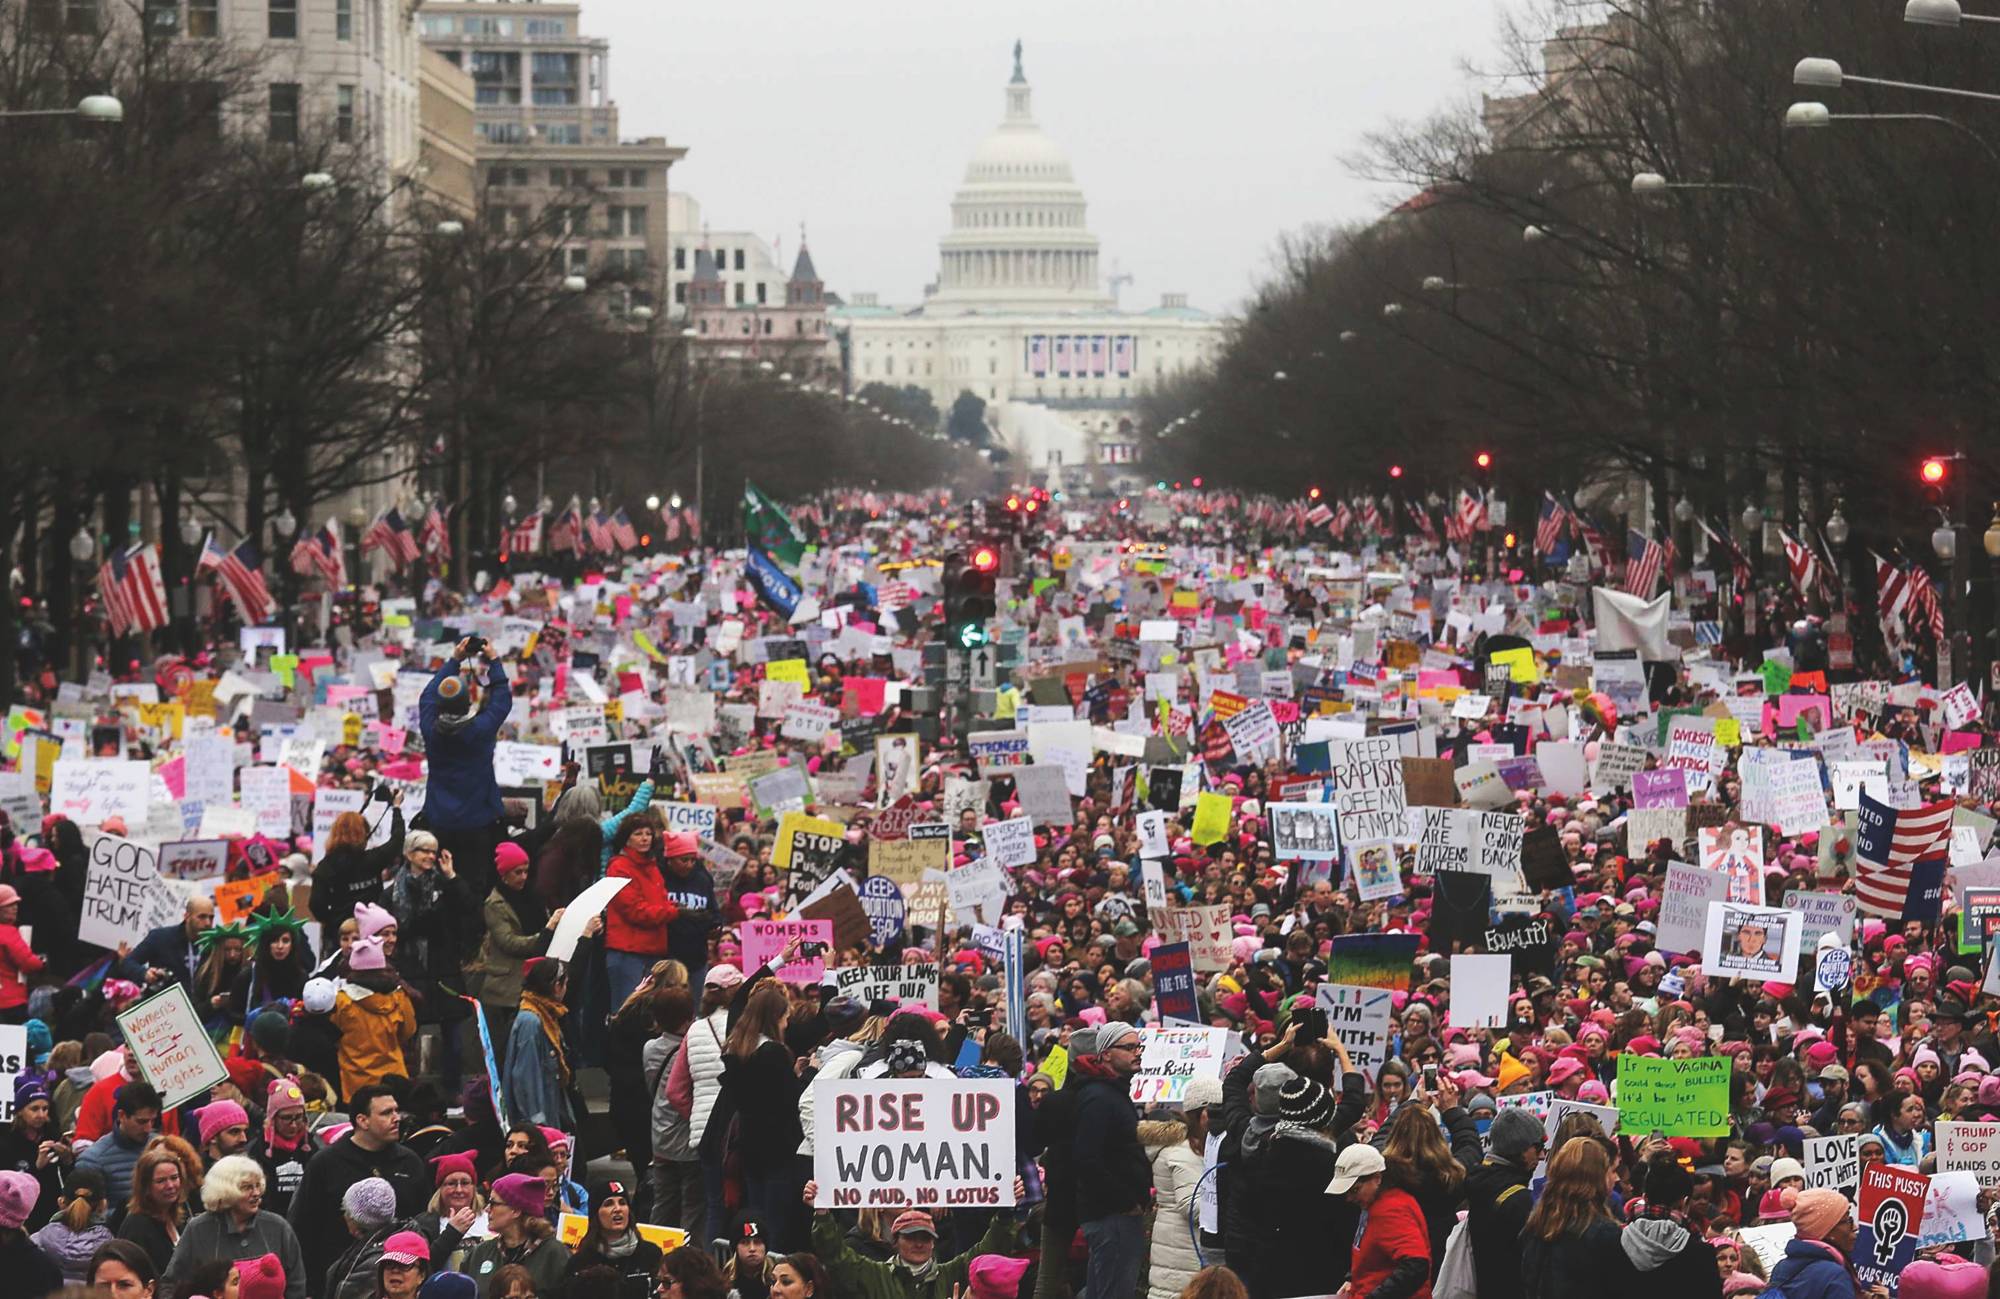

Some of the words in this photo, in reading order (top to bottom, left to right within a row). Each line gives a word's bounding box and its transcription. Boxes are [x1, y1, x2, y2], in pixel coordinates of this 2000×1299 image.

[970, 740, 1029, 756] STRONGER
[1345, 740, 1390, 764] KEEP
[1333, 759, 1403, 792] RAPISTS
[1381, 787, 1404, 816] MY
[1343, 811, 1409, 841] CAMPUS
[1425, 807, 1453, 830] WE
[1481, 813, 1524, 834] NEVER
[794, 832, 843, 853] STOP
[1421, 828, 1450, 845] ARE
[93, 836, 156, 881] GOD
[1420, 845, 1468, 863] CITIZENS
[1482, 849, 1517, 872] BACK
[1418, 860, 1464, 874] UNITED
[866, 878, 896, 895] KEEP
[921, 883, 945, 895] MY
[1800, 899, 1813, 910] MY
[1816, 900, 1837, 912] BODY
[1210, 909, 1229, 927] WE
[1803, 911, 1842, 926] DECISION
[753, 925, 819, 936] WOMENS
[1484, 919, 1548, 952] EQUALITY
[837, 968, 870, 989] KEEP
[870, 966, 903, 983] YOUR
[864, 984, 890, 1001] OFF
[899, 983, 926, 1000] OUR
[1332, 1006, 1362, 1022] I'M
[1336, 1028, 1376, 1047] ITH
[1673, 1060, 1723, 1074] VAGINA
[1684, 1074, 1728, 1088] BULLETS
[1653, 1092, 1667, 1103] be
[835, 1092, 925, 1132] RISE
[951, 1092, 1001, 1133] UP
[1619, 1109, 1723, 1127] REGULATED
[1954, 1127, 1987, 1139] TRUMP
[1813, 1136, 1857, 1165] LOVE
[1961, 1142, 1988, 1153] GOP
[835, 1141, 1002, 1183] WOMAN.
[1946, 1160, 1987, 1172] HANDS
[1805, 1167, 1833, 1191] NOT
[1835, 1161, 1859, 1186] HATE
[1867, 1170, 1892, 1192] THIS
[1894, 1176, 1928, 1199] PUSSY
[833, 1188, 862, 1207] NO
[868, 1187, 913, 1207] MUD,
[916, 1187, 939, 1205] NO
[945, 1186, 1000, 1205] LOTUS
